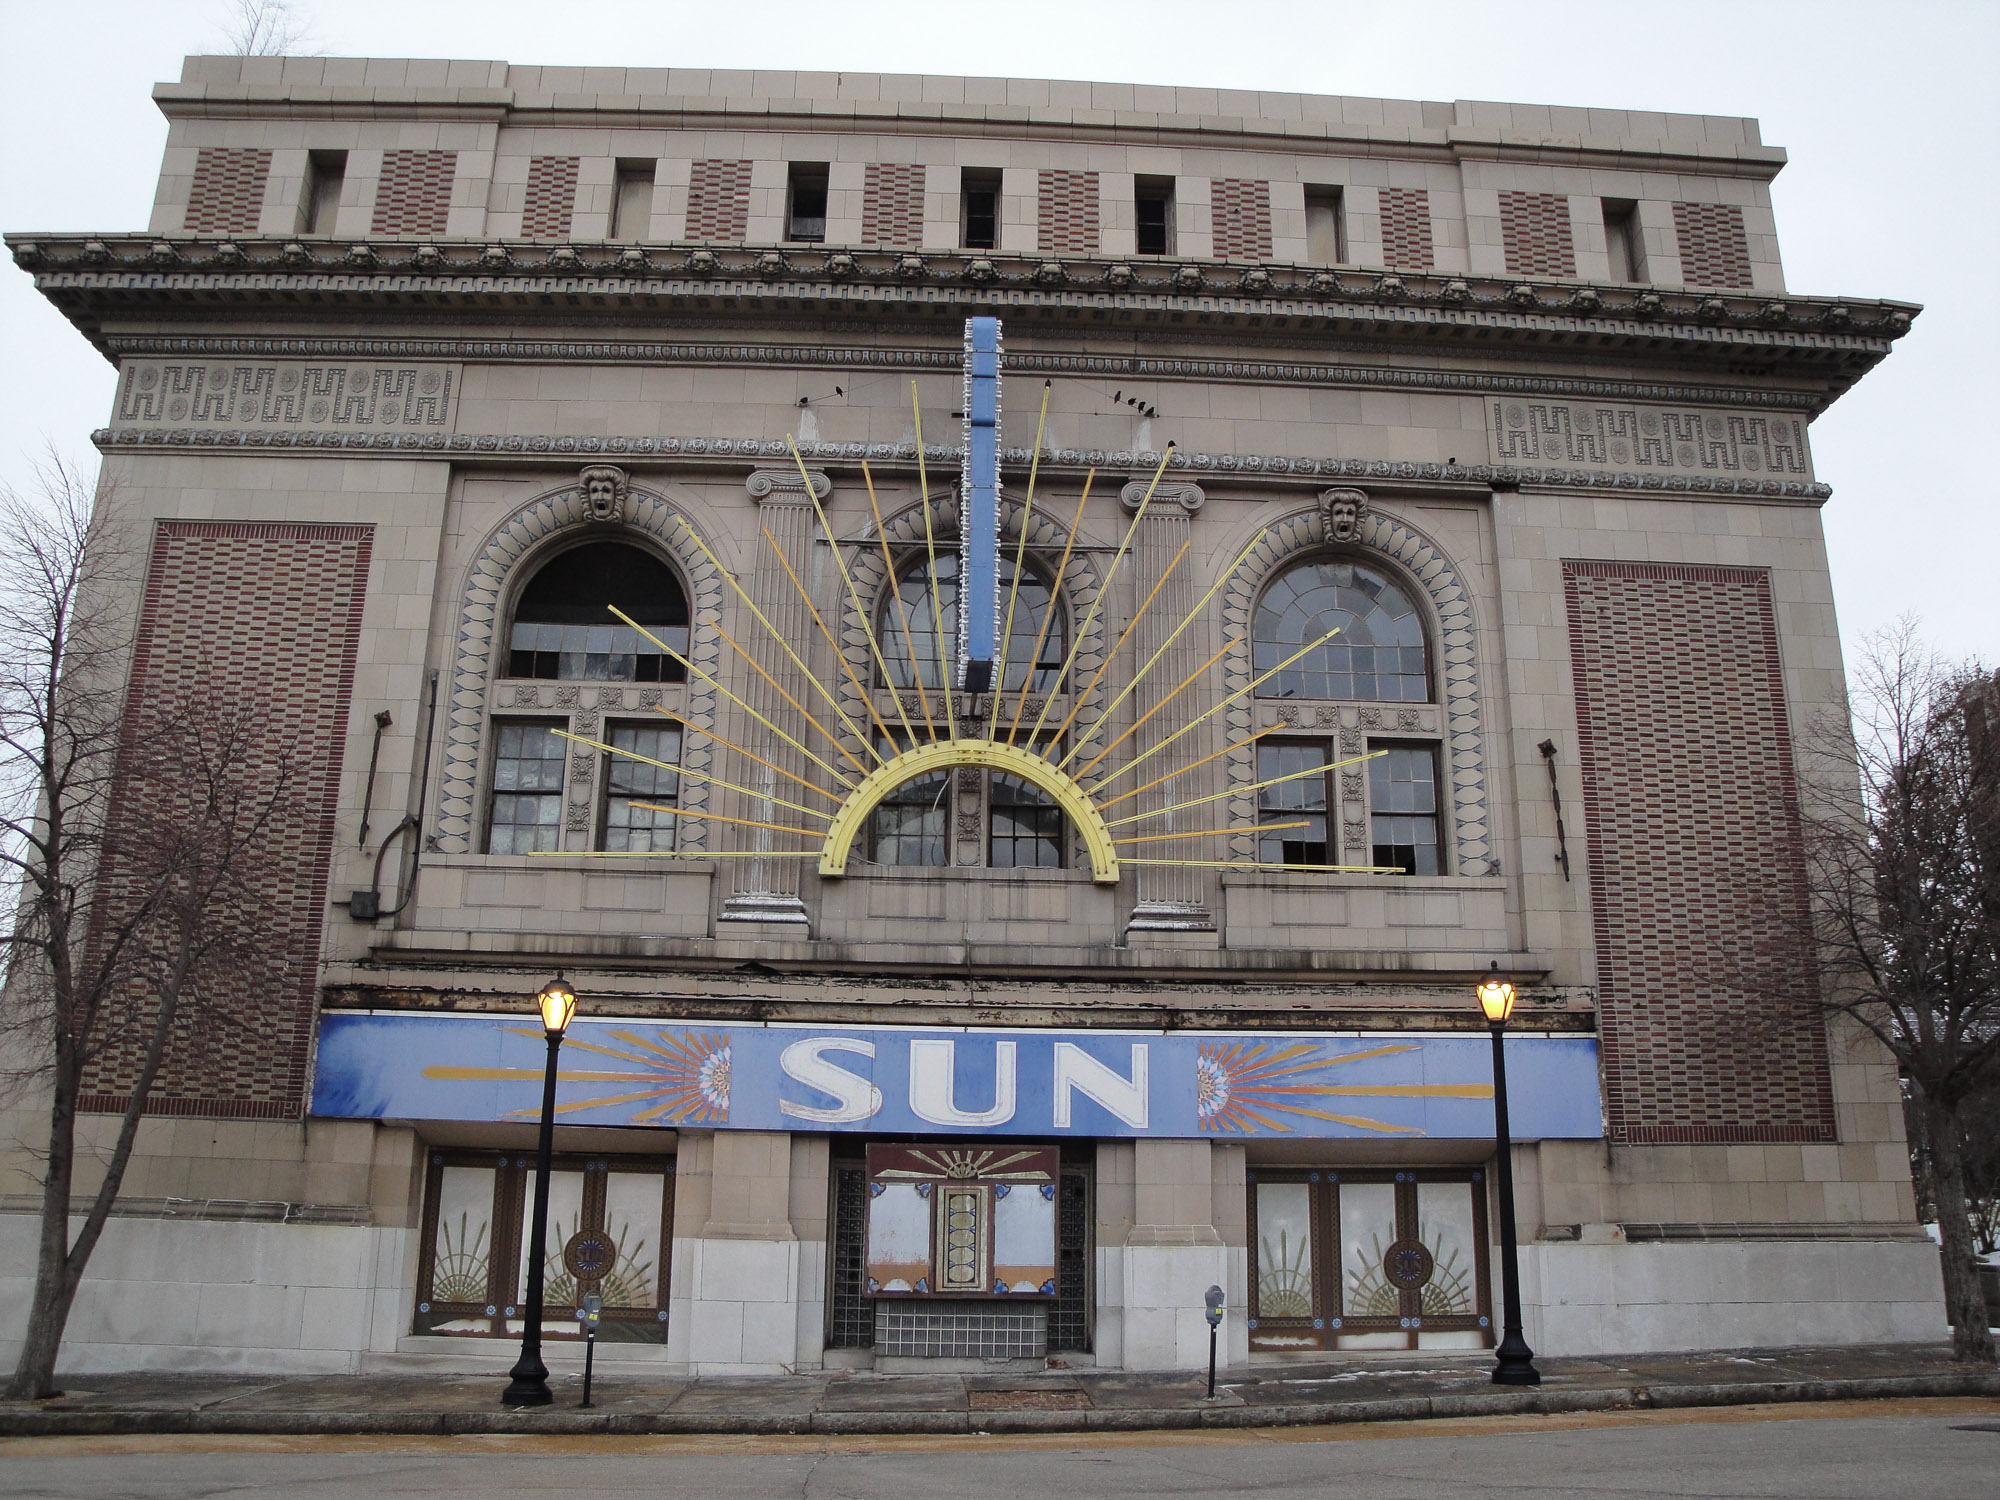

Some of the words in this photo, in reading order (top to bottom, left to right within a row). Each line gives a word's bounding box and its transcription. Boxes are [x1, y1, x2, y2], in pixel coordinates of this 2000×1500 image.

[779, 1036, 1149, 1129] SUN
[575, 1248, 604, 1262] SUN
[1394, 1259, 1422, 1272] SUN
